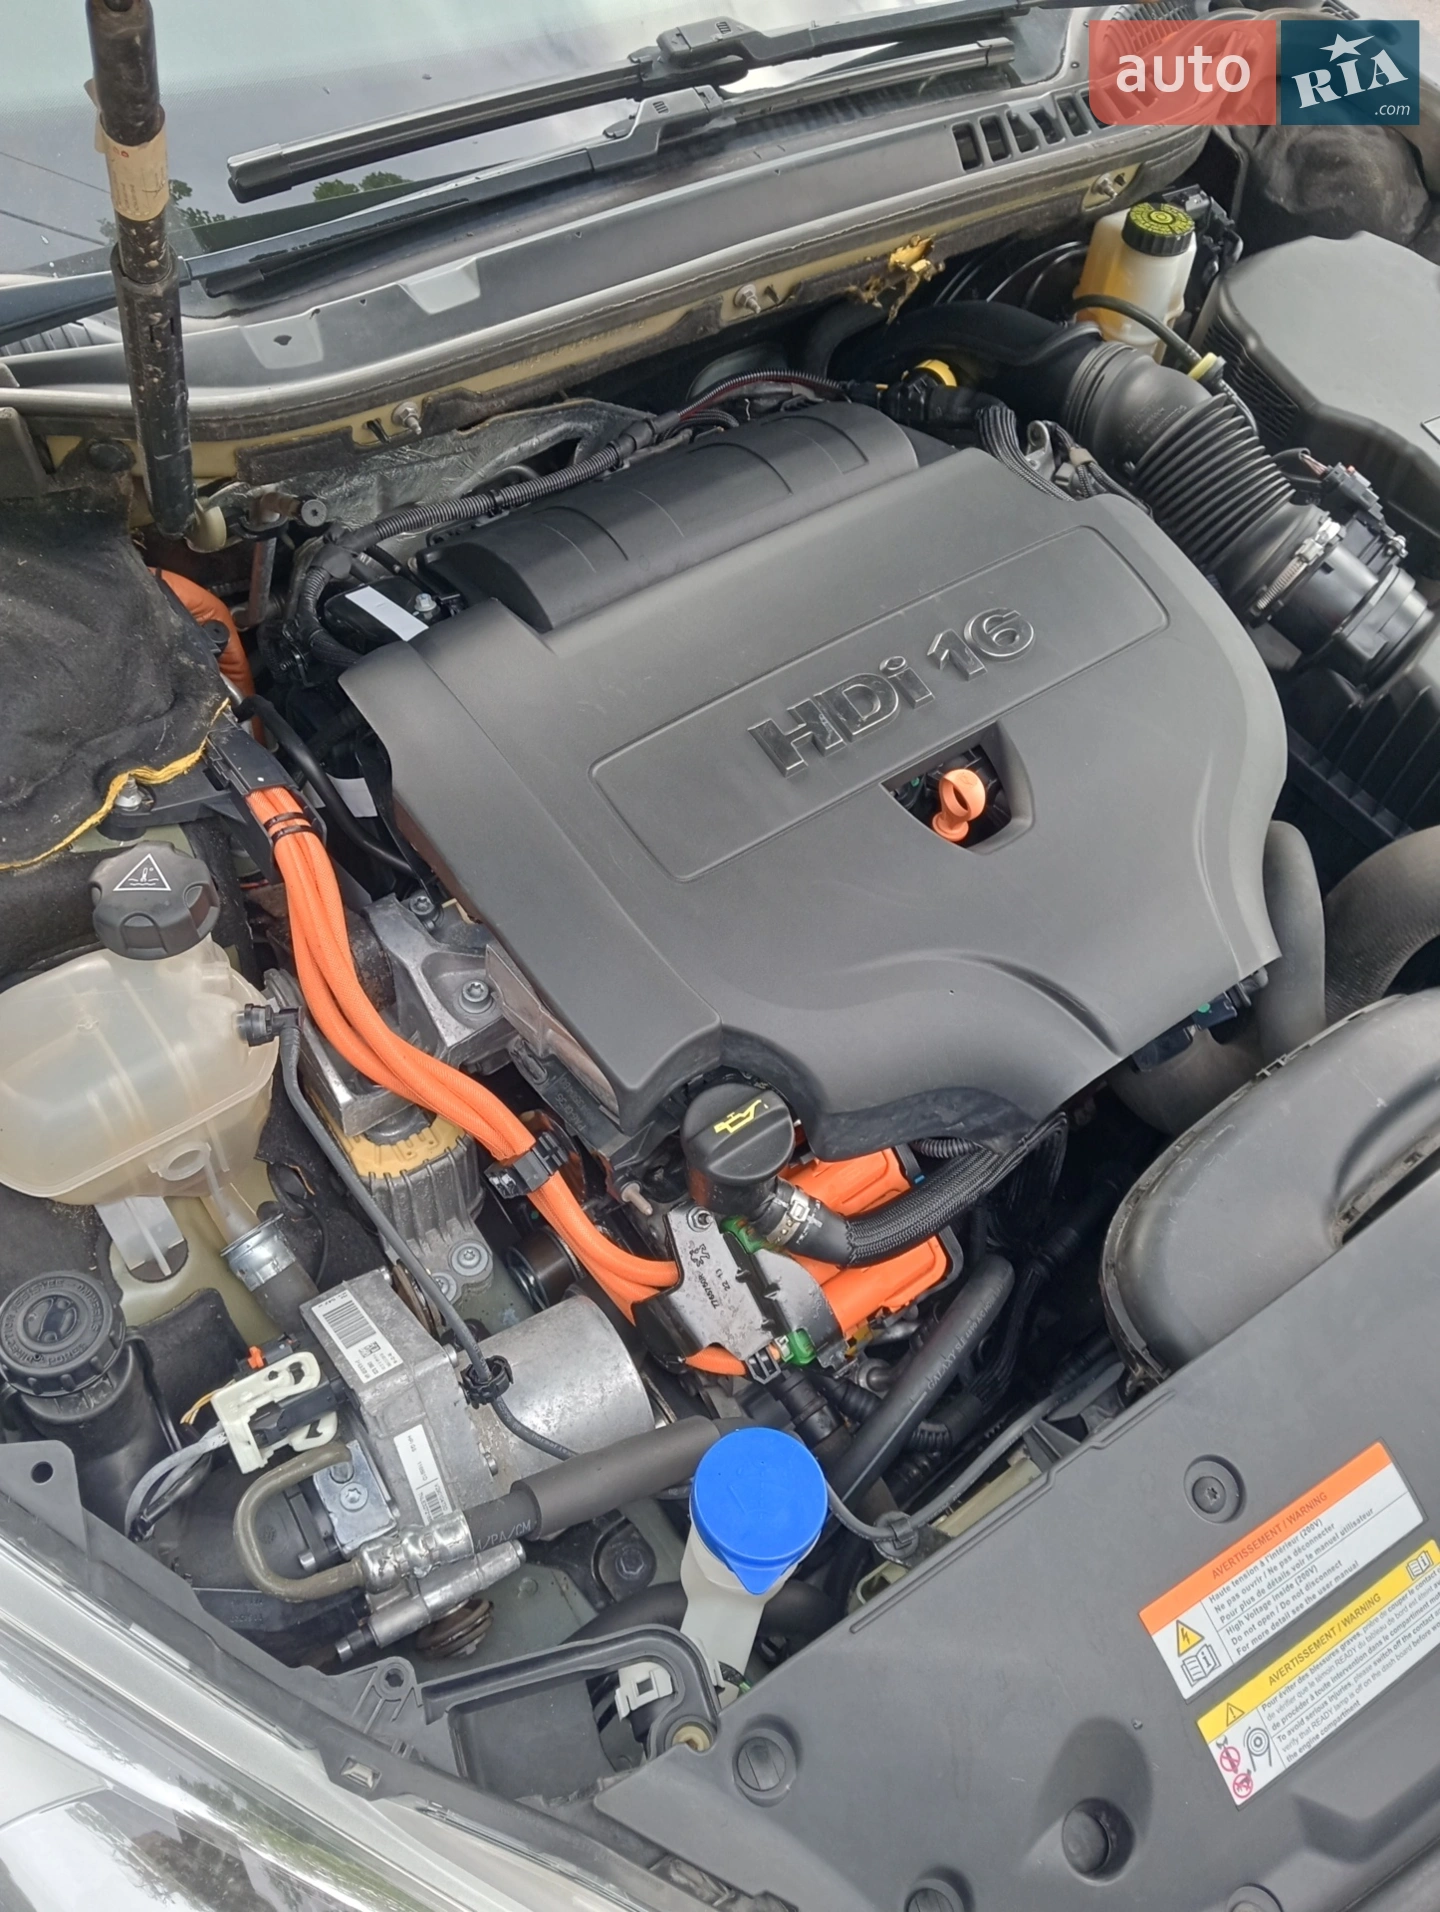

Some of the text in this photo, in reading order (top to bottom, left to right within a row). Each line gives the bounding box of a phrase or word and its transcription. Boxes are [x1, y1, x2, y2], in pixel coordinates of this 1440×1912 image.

[747, 607, 1037, 778] HDi 16
[924, 1347, 959, 1392] GALAXY
[1208, 1586, 1231, 1603] Haute
[1231, 1563, 1259, 1587] tension
[1258, 1559, 1265, 1567] à
[1299, 1517, 1323, 1539] (200V)
[1212, 1492, 1327, 1579] AVERTISSEMENT / WARNING
[1214, 1603, 1225, 1614] Ne
[1226, 1593, 1240, 1607] pas
[1241, 1576, 1262, 1594] ouvrir
[1267, 1565, 1278, 1575] Ne
[1279, 1555, 1292, 1569] pas
[1293, 1523, 1335, 1557] déconnecter
[1220, 1508, 1373, 1624] Pour plus de détails voir le manuel utilisateur
[1226, 1564, 1318, 1635] High Voltage inside (200V)
[1231, 1635, 1243, 1645] Do
[1243, 1624, 1256, 1637] not
[1257, 1611, 1275, 1627] open
[1279, 1599, 1290, 1610] Do
[1291, 1588, 1304, 1601] not
[1305, 1560, 1342, 1591] disconnect
[1236, 1560, 1359, 1655] For more detail see the user manual
[1261, 1696, 1277, 1711] Pour
[1277, 1682, 1296, 1698] éviter
[1296, 1673, 1308, 1684] des
[1307, 1649, 1339, 1674] blessures
[1379, 1610, 1386, 1619] de
[1388, 1593, 1408, 1612] couper
[1407, 1586, 1414, 1595] le
[1414, 1570, 1437, 1590] contact
[1268, 1592, 1381, 1686] AVERTISSEMENT / WARNING
[1267, 1712, 1275, 1721] de
[1297, 1686, 1309, 1698] que
[1334, 1646, 1357, 1667] READY
[1358, 1640, 1366, 1649] du
[1365, 1624, 1387, 1642] tableau
[1387, 1617, 1395, 1625] de
[1394, 1605, 1408, 1619] bord
[1408, 1598, 1417, 1608] est
[1272, 1722, 1280, 1731] de
[1281, 1698, 1309, 1724] procéder
[1314, 1681, 1331, 1697] toute
[1330, 1652, 1368, 1683] intervention
[1368, 1640, 1383, 1654] dans
[1390, 1602, 1430, 1636] compartiment
[1277, 1734, 1286, 1742] To
[1287, 1718, 1305, 1736] avoid
[1305, 1700, 1328, 1721] serious
[1353, 1664, 1372, 1684] please
[1370, 1648, 1393, 1666] switch
[1393, 1639, 1402, 1650] off
[1401, 1633, 1412, 1643] the
[1412, 1613, 1434, 1634] contact
[1298, 1726, 1312, 1739] that
[1311, 1707, 1333, 1729] READY
[1333, 1697, 1349, 1711] lamp
[1355, 1683, 1363, 1694] off
[1364, 1678, 1372, 1687] on
[1372, 1670, 1381, 1680] the
[1381, 1658, 1396, 1672] dash
[1395, 1643, 1412, 1661] board
[1411, 1629, 1431, 1647] before
[1286, 1699, 1361, 1762] the engine compartment
